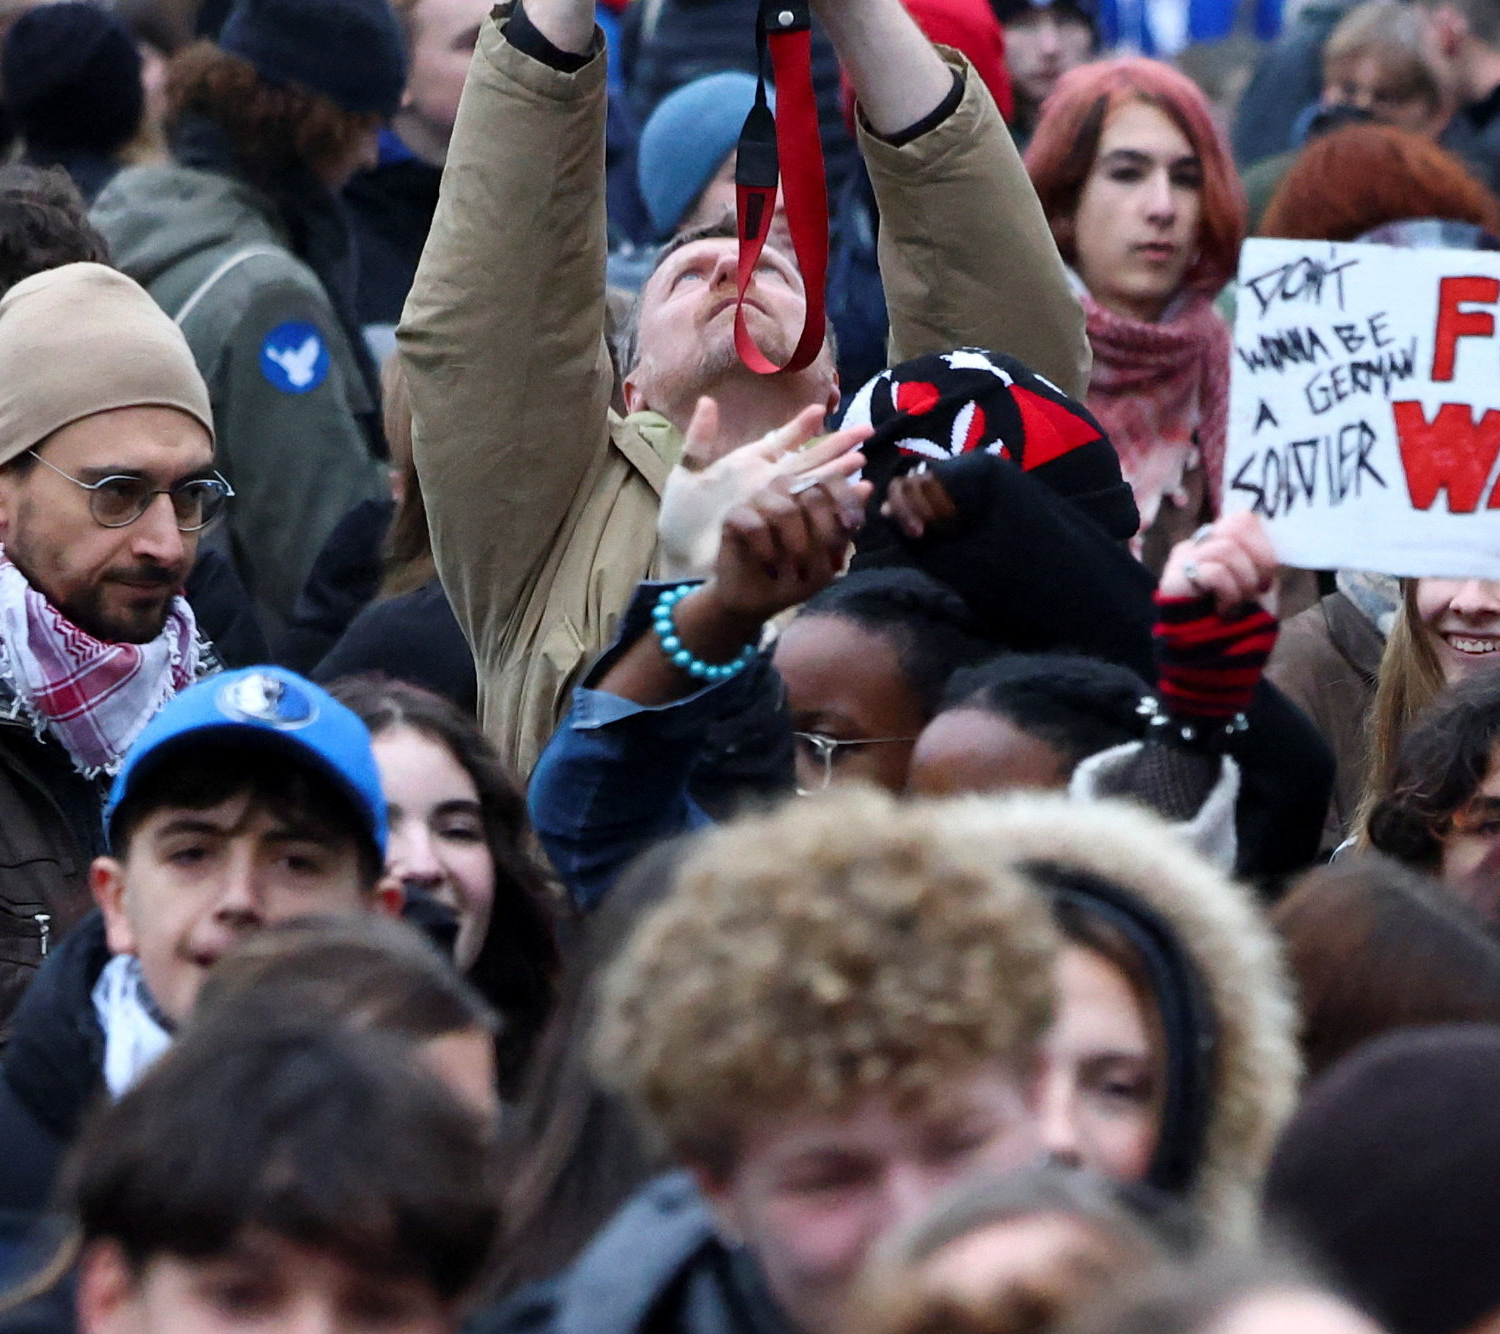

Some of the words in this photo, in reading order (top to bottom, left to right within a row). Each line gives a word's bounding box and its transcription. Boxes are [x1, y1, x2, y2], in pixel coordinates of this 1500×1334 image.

[1235, 325, 1332, 375] WANNA
[1332, 311, 1396, 354] BE
[1253, 397, 1280, 436] A
[1304, 335, 1418, 416] GERMAN
[1230, 419, 1389, 520] SOLDIER
